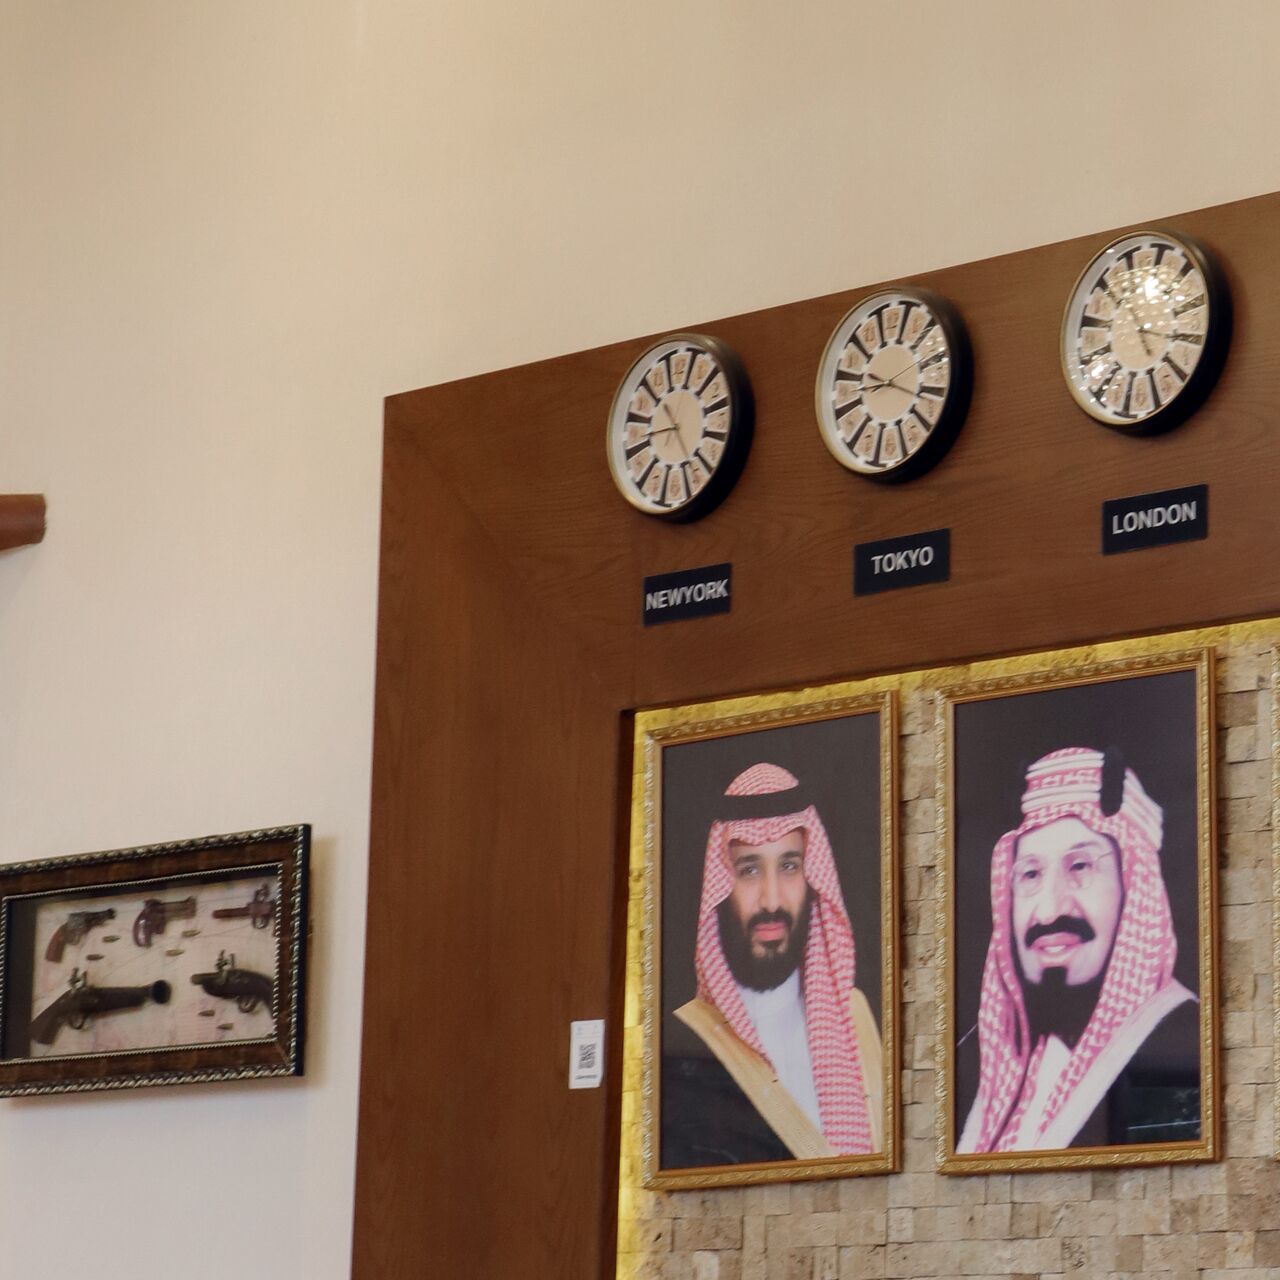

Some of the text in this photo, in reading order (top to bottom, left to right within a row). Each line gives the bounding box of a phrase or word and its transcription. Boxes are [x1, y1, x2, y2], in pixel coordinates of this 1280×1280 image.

[1112, 500, 1198, 535] LONDON
[870, 545, 935, 576] TOKYO
[645, 578, 729, 612] NEWYORK
